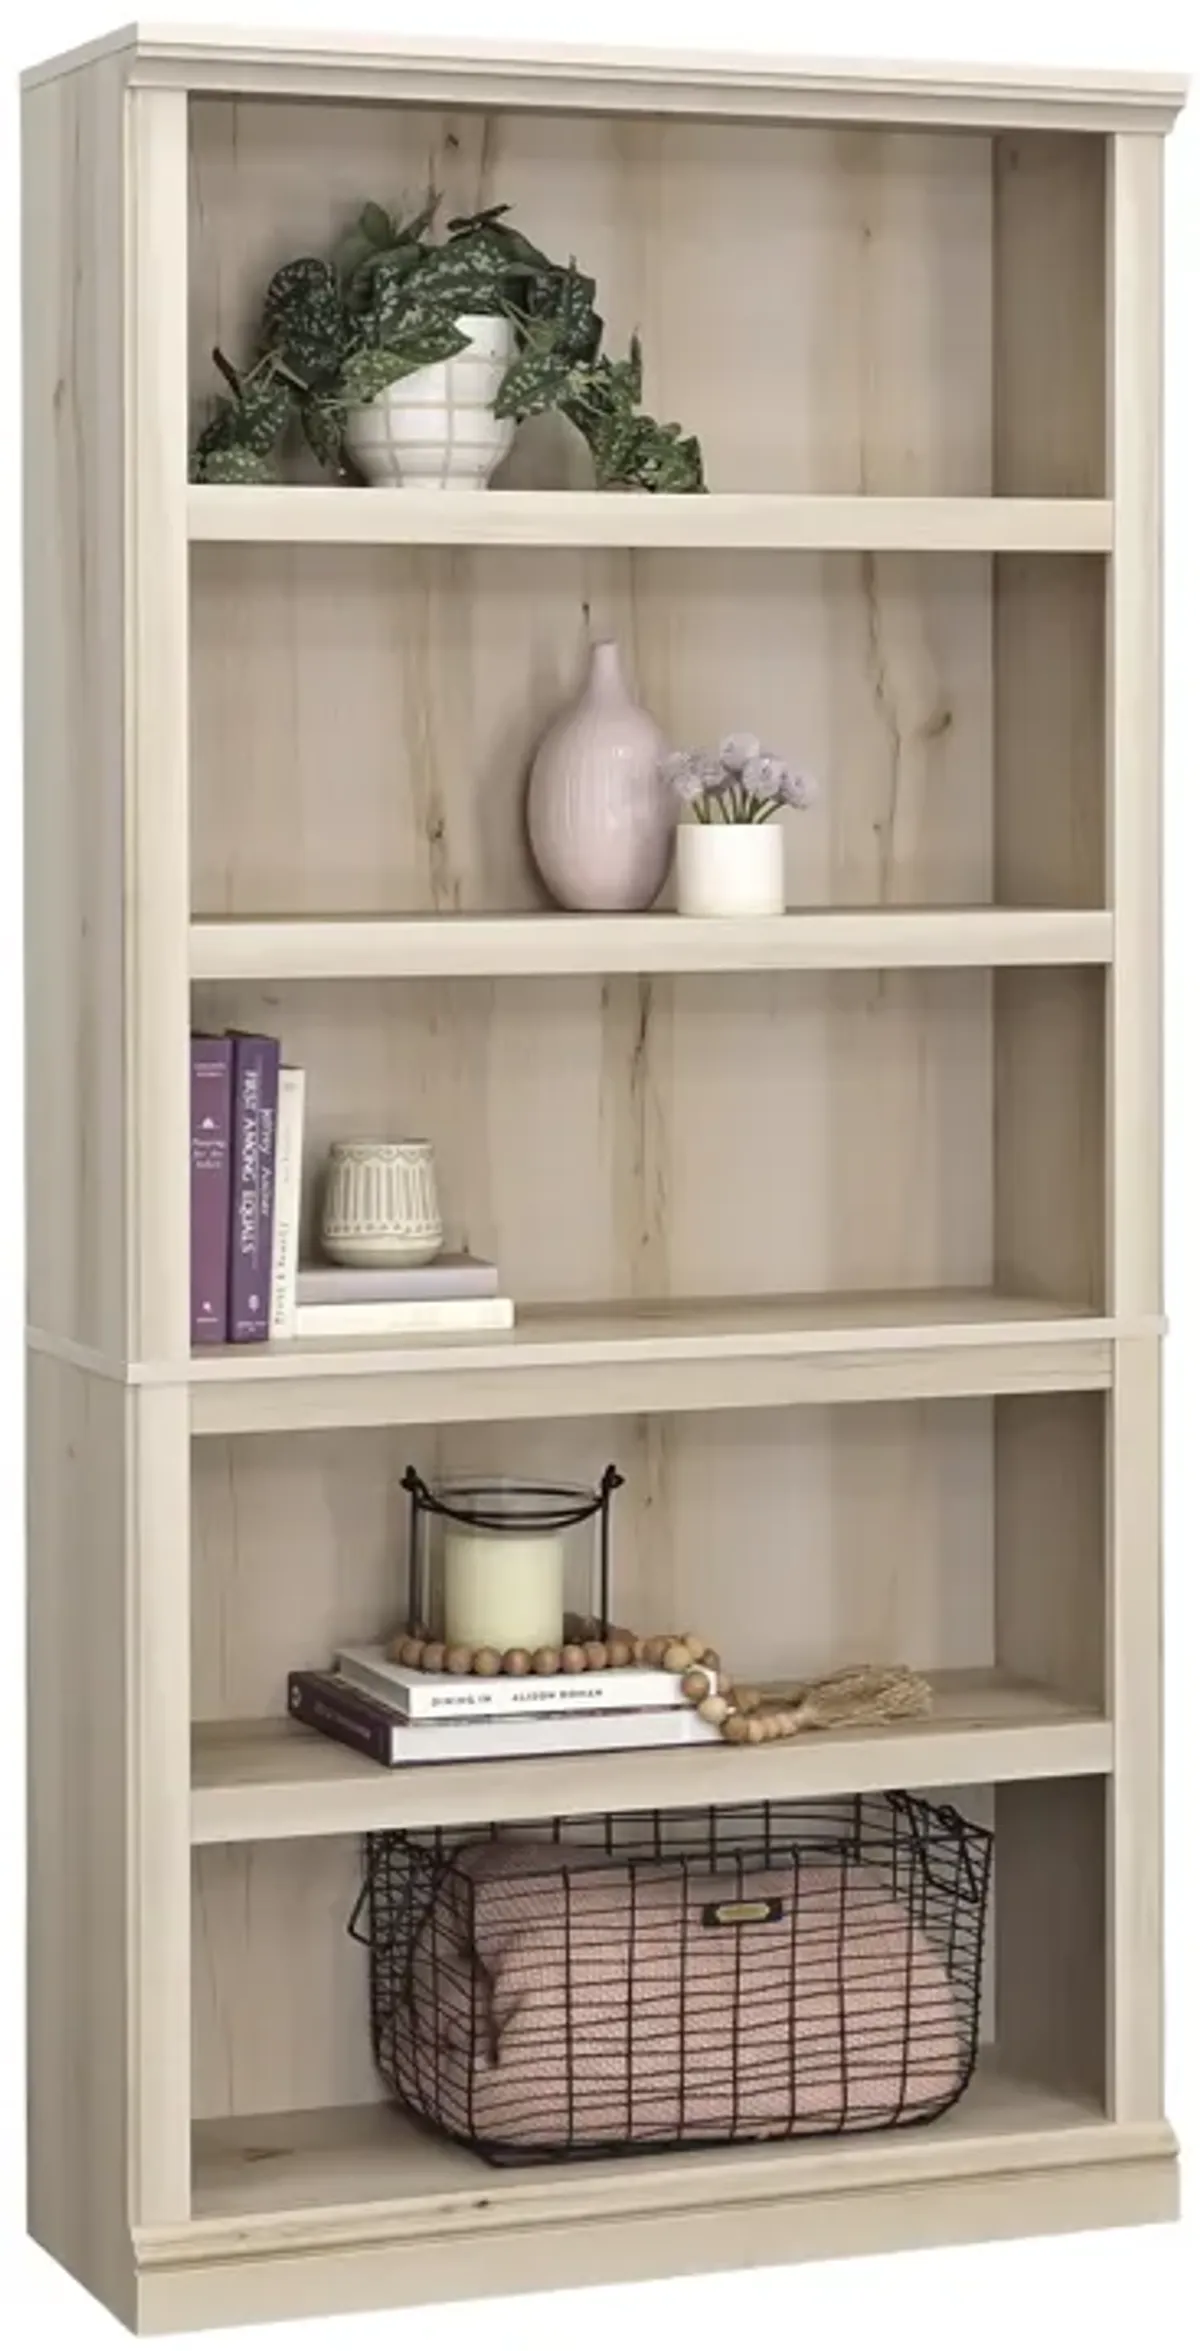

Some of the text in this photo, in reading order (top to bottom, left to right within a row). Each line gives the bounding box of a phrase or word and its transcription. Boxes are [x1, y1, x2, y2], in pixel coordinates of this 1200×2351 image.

[239, 1070, 258, 1255] FIRST AMONG EQUALS
